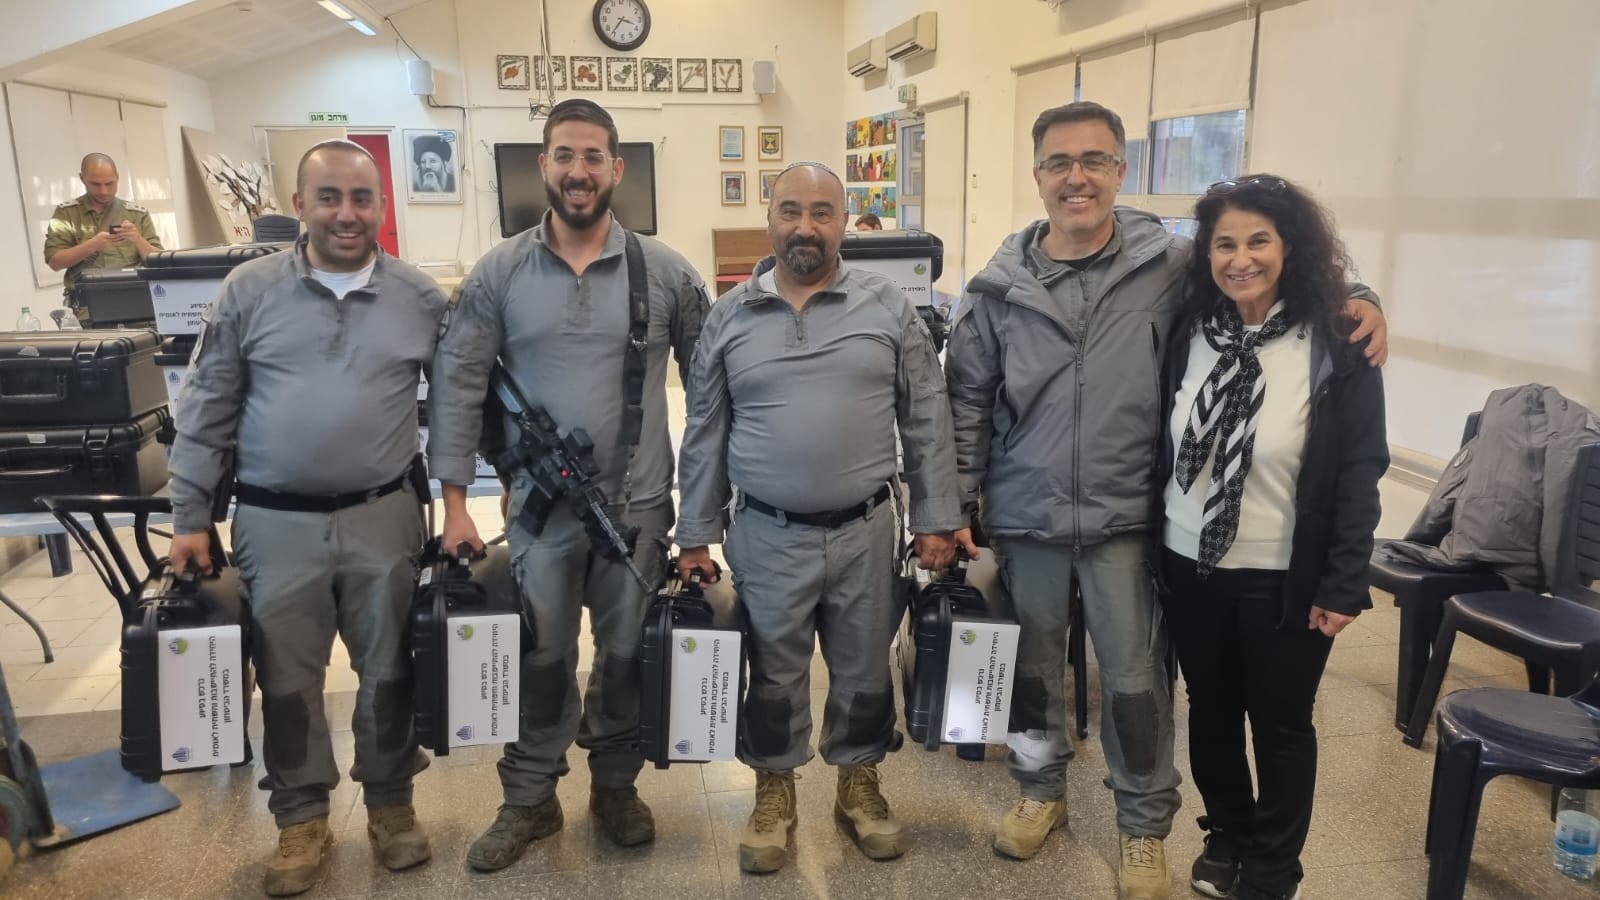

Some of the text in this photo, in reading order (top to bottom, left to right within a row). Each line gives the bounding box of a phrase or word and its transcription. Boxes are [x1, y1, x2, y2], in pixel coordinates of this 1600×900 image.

[990, 632, 999, 654] היחידה
[976, 668, 985, 684] נרכש
[994, 663, 1006, 712] במשרד הביטחון
[223, 695, 232, 723] הביטחון
[980, 718, 989, 740] לאומית
[211, 732, 219, 757] לאומית
